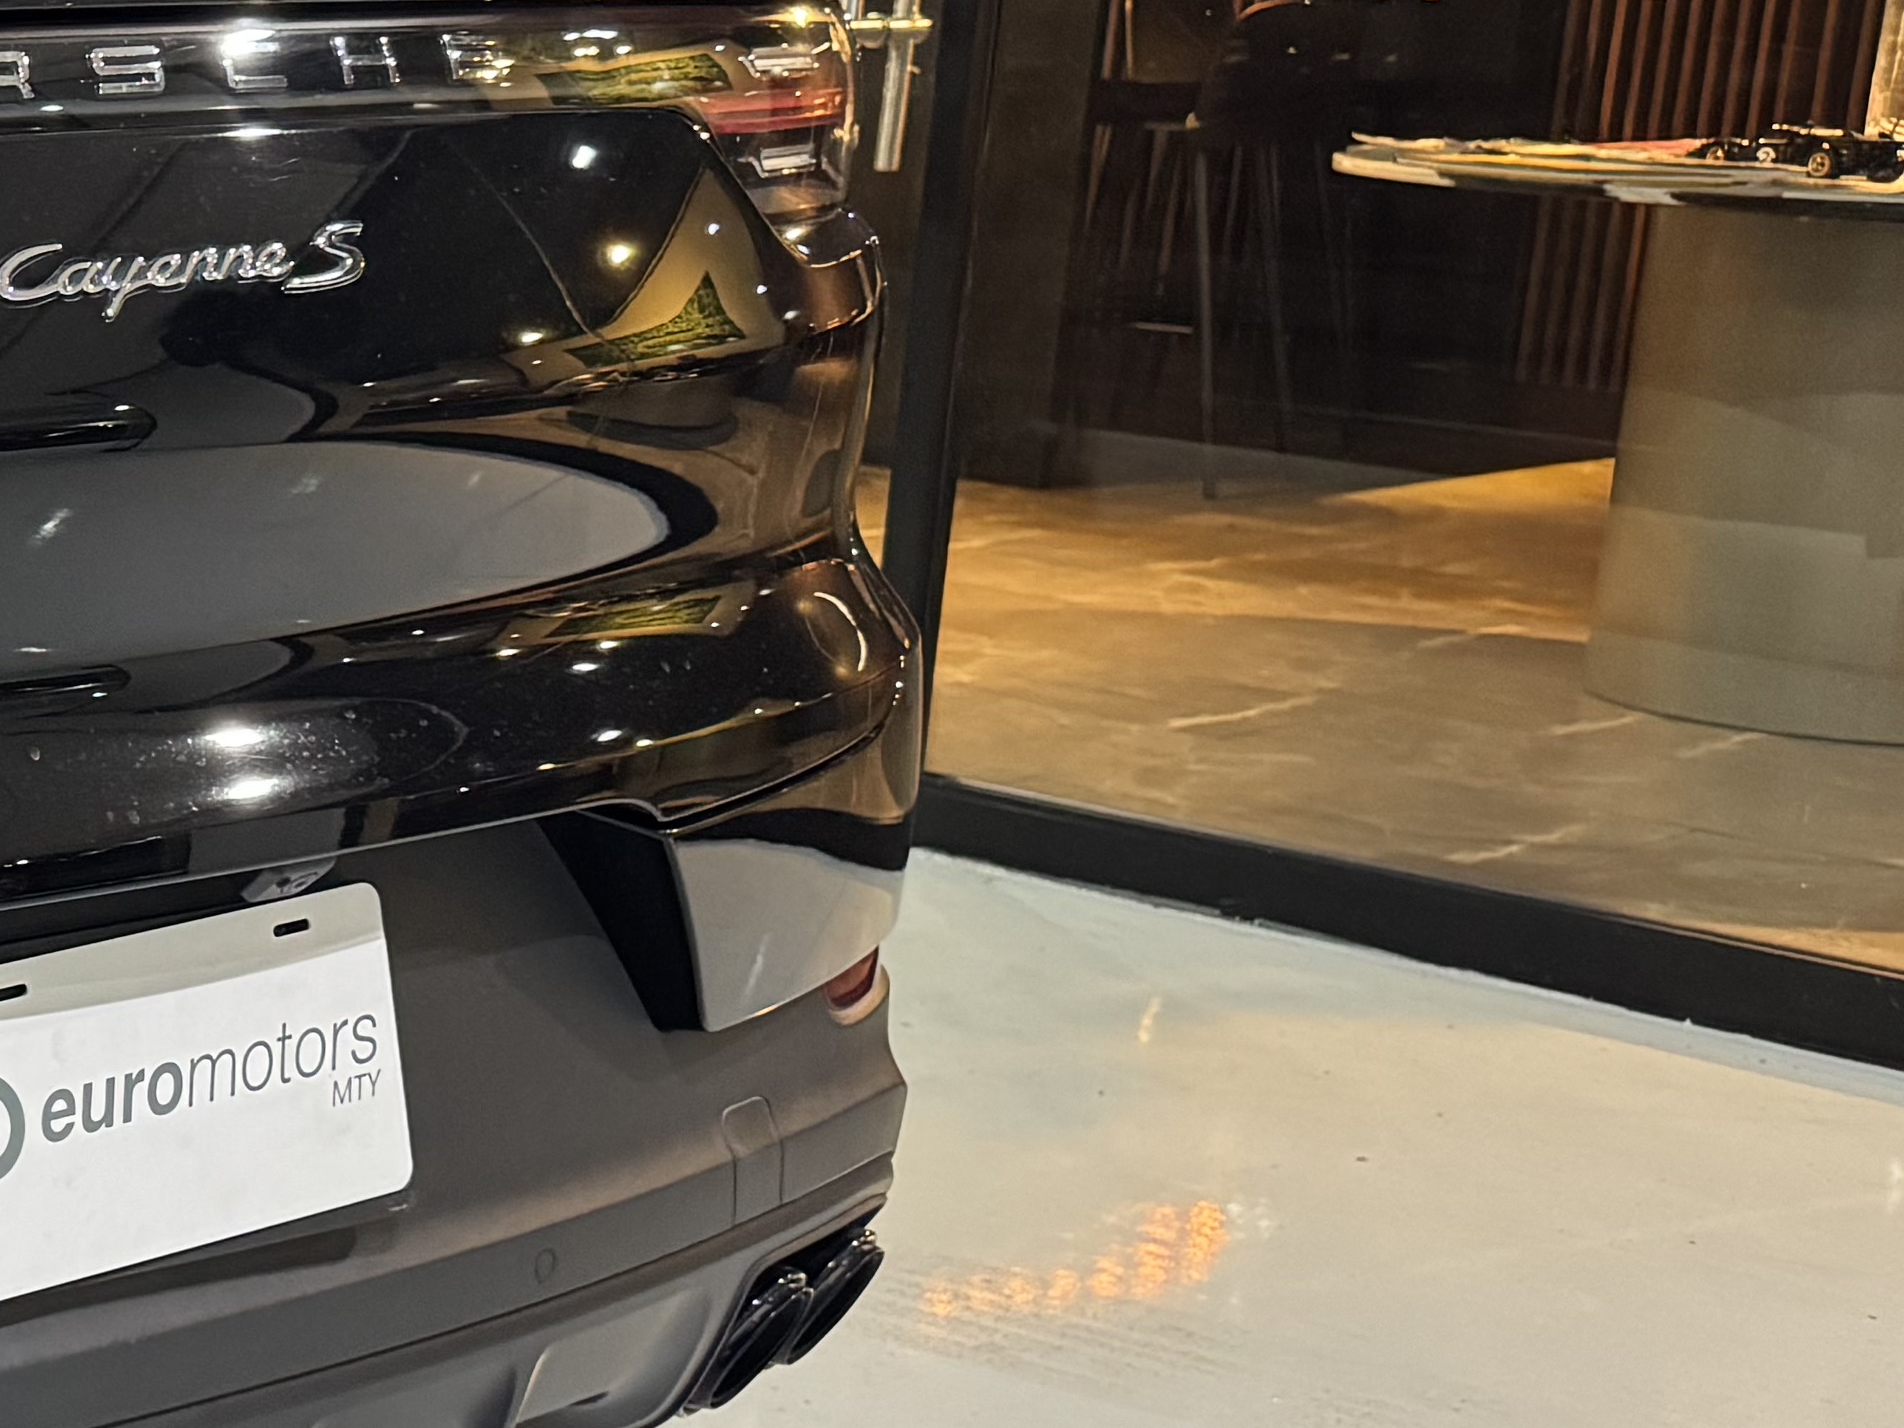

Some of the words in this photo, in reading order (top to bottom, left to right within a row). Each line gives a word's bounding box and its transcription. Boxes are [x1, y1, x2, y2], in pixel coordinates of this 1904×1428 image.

[283, 219, 365, 295] S
[40, 1013, 378, 1143] euromotors
[331, 1068, 382, 1108] MTY
